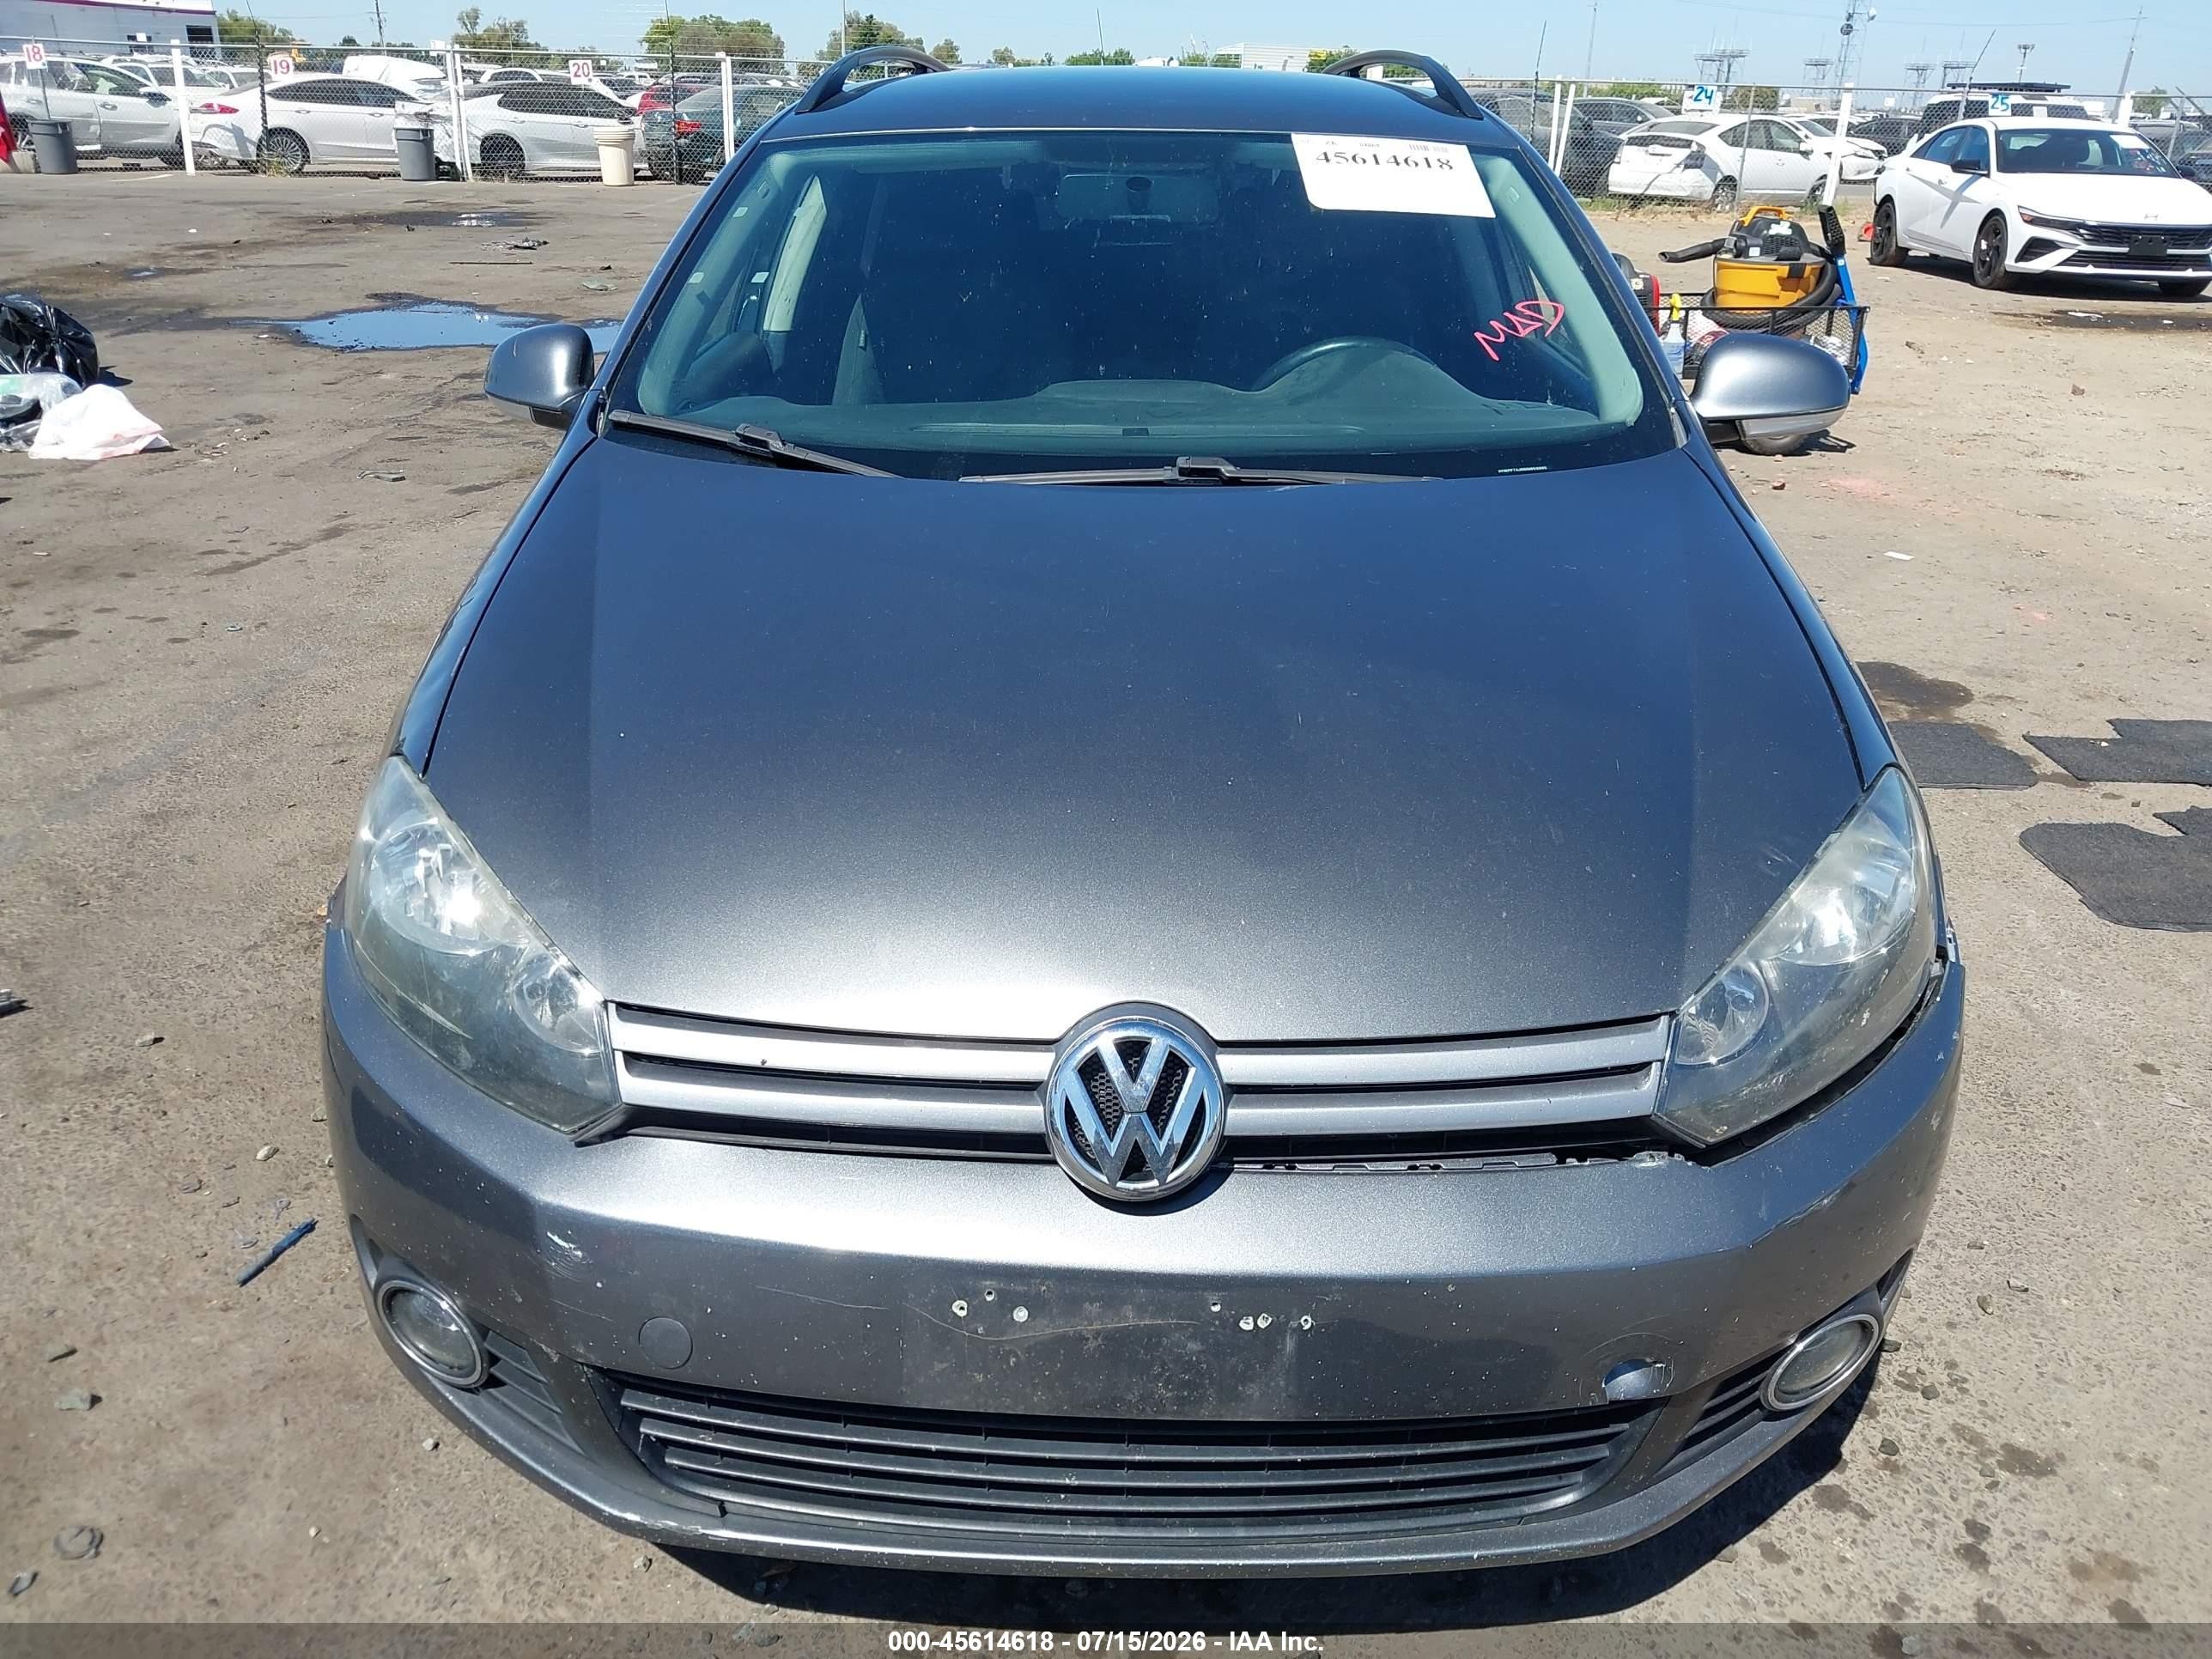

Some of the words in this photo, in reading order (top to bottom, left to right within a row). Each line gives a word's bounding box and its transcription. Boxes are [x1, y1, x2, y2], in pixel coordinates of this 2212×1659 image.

[26, 45, 43, 63] 18
[273, 59, 290, 75] 19
[572, 62, 591, 78] 20
[1693, 86, 1714, 105] 24
[1990, 94, 2010, 112] 25
[1316, 150, 1454, 171] 45614618
